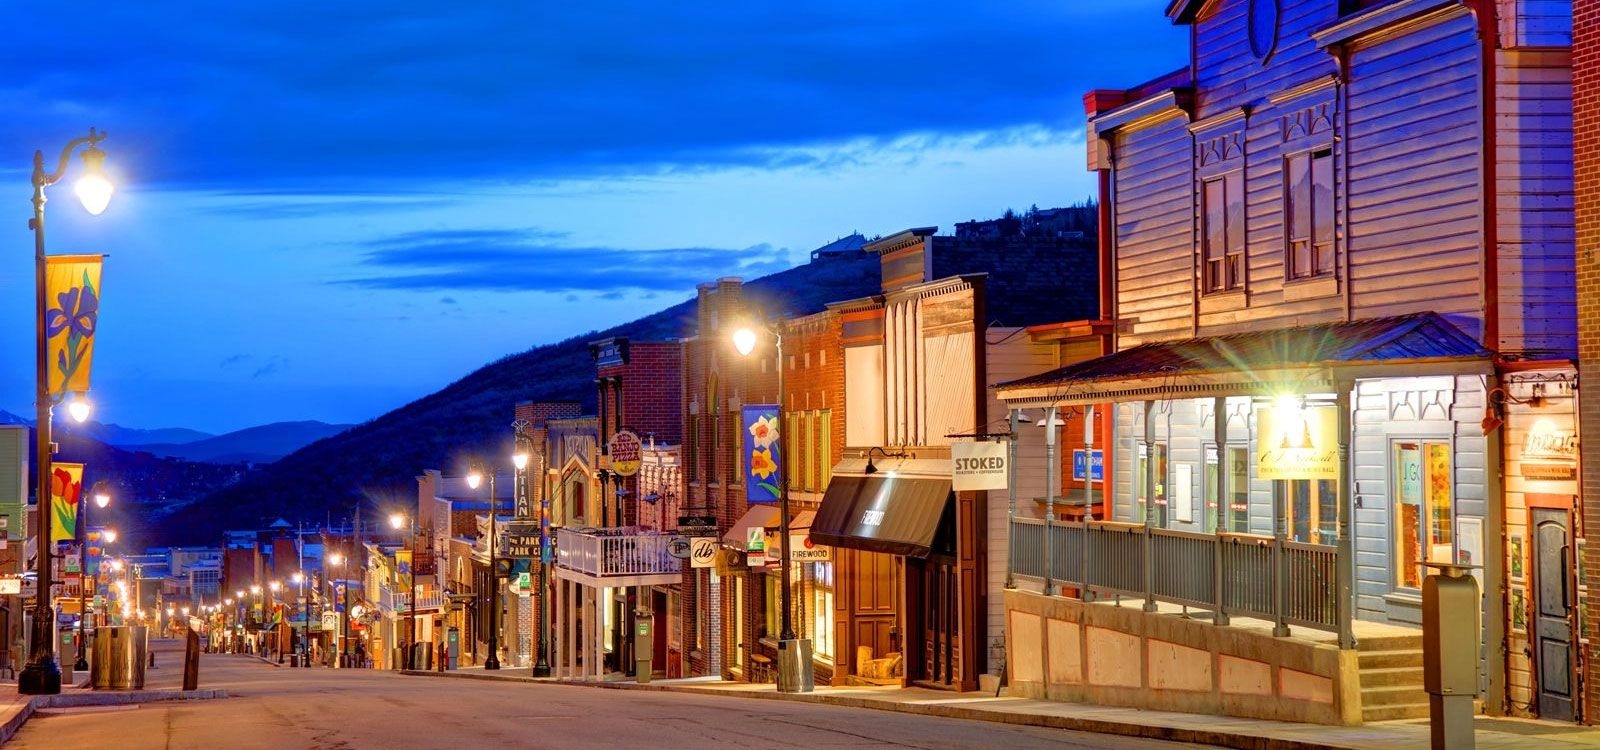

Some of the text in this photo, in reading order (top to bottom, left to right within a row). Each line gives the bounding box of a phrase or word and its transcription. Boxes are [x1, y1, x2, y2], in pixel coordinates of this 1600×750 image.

[617, 434, 631, 442] RED
[611, 442, 640, 452] BANJO
[612, 452, 640, 462] PIZZA
[955, 457, 1004, 470] STOKED
[520, 536, 540, 546] PARK
[509, 547, 529, 556] PARK
[694, 542, 713, 559] db
[792, 550, 828, 558] FIREWOOD
